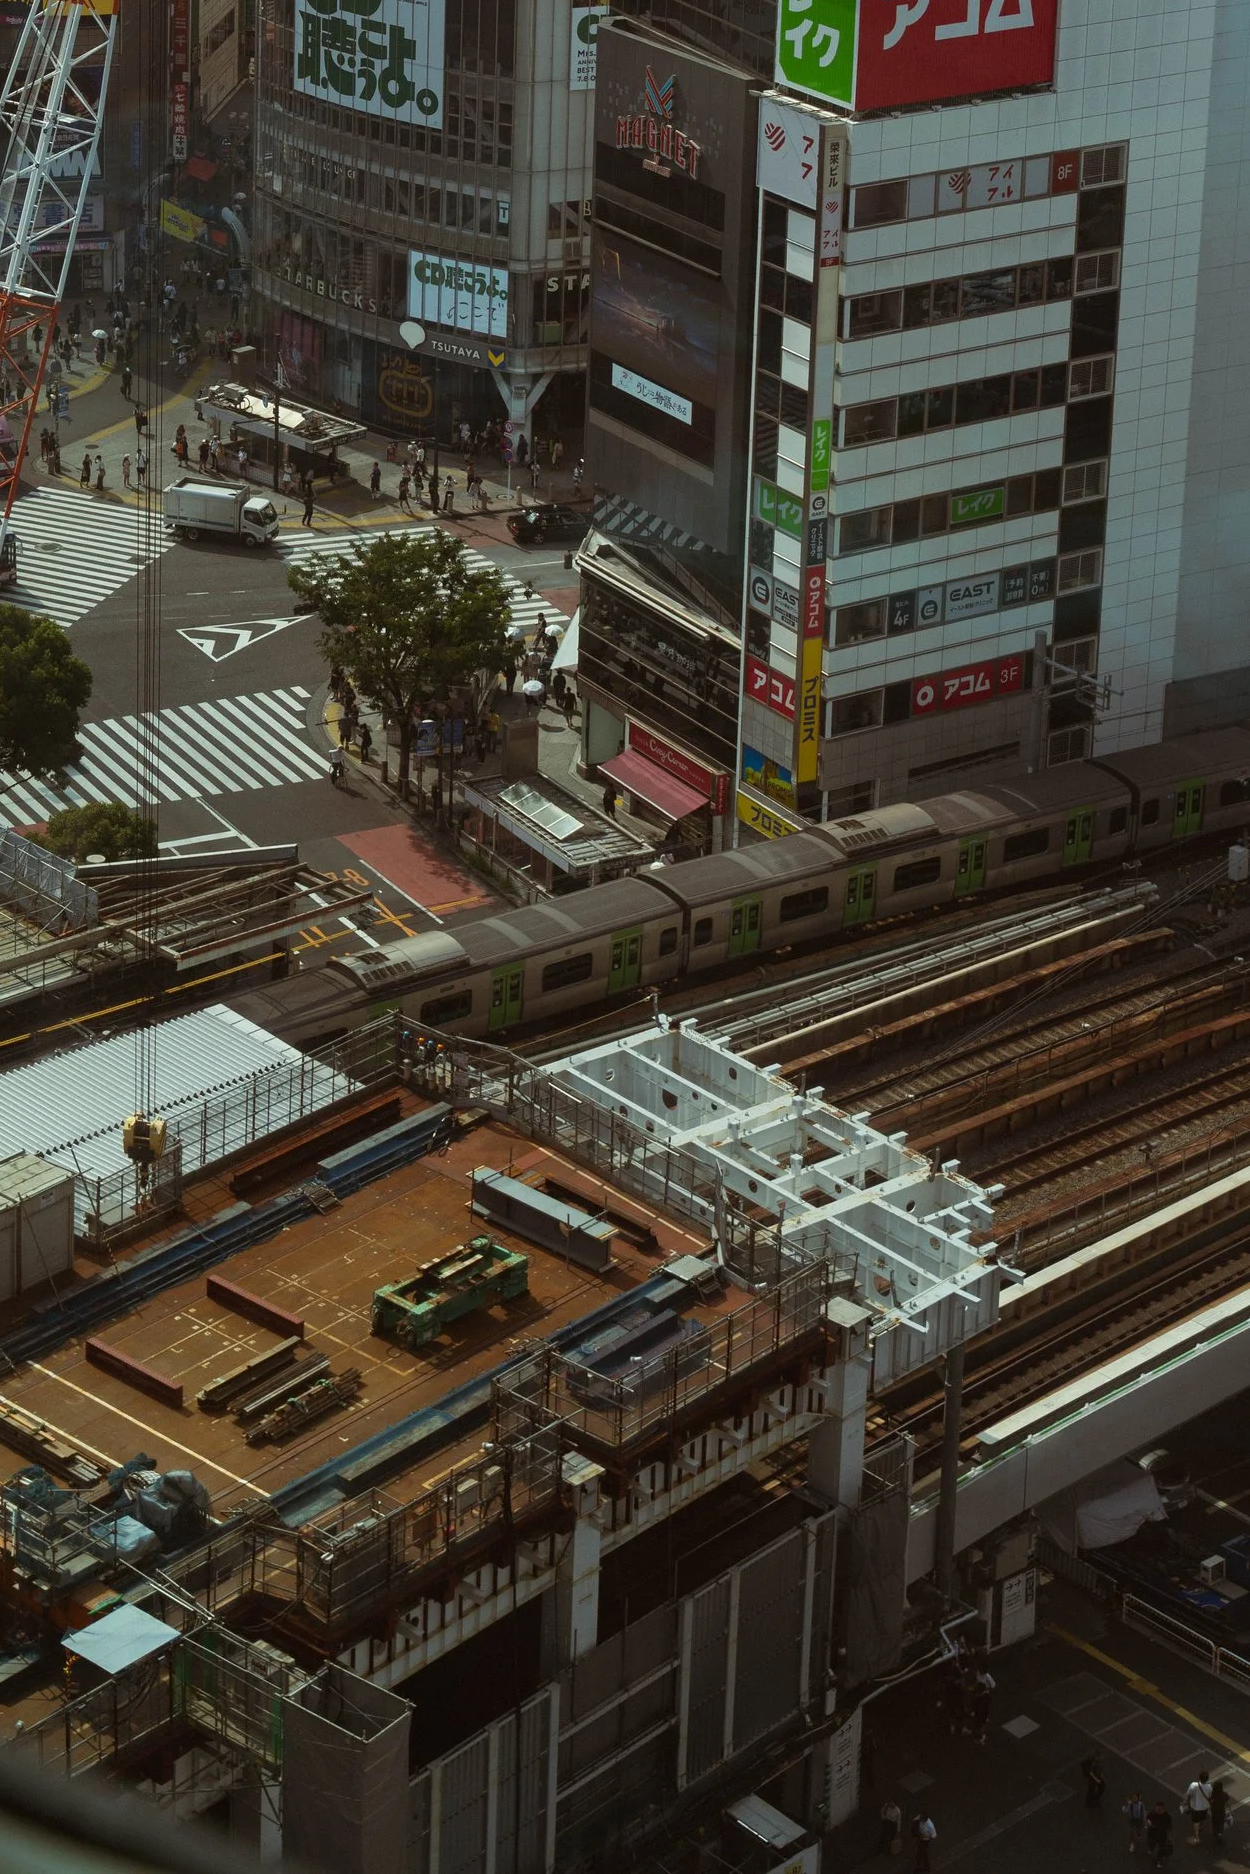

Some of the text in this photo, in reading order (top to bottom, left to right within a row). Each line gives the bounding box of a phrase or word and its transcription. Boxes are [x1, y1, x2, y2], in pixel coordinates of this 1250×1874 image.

[783, 24, 840, 68] イク
[616, 115, 701, 180] MAGNET
[1057, 163, 1073, 182] 8F
[276, 266, 377, 313] STARBUCKS
[431, 339, 481, 360] TSUTAYA
[815, 427, 826, 463] レイク
[762, 483, 802, 525] レイク
[957, 493, 995, 516] レイク
[950, 581, 994, 601] EAST
[808, 590, 821, 629] アコム
[894, 611, 910, 627] 4F
[944, 672, 991, 700] アコム
[1000, 667, 1018, 684] 3F
[802, 676, 819, 743] プロミス
